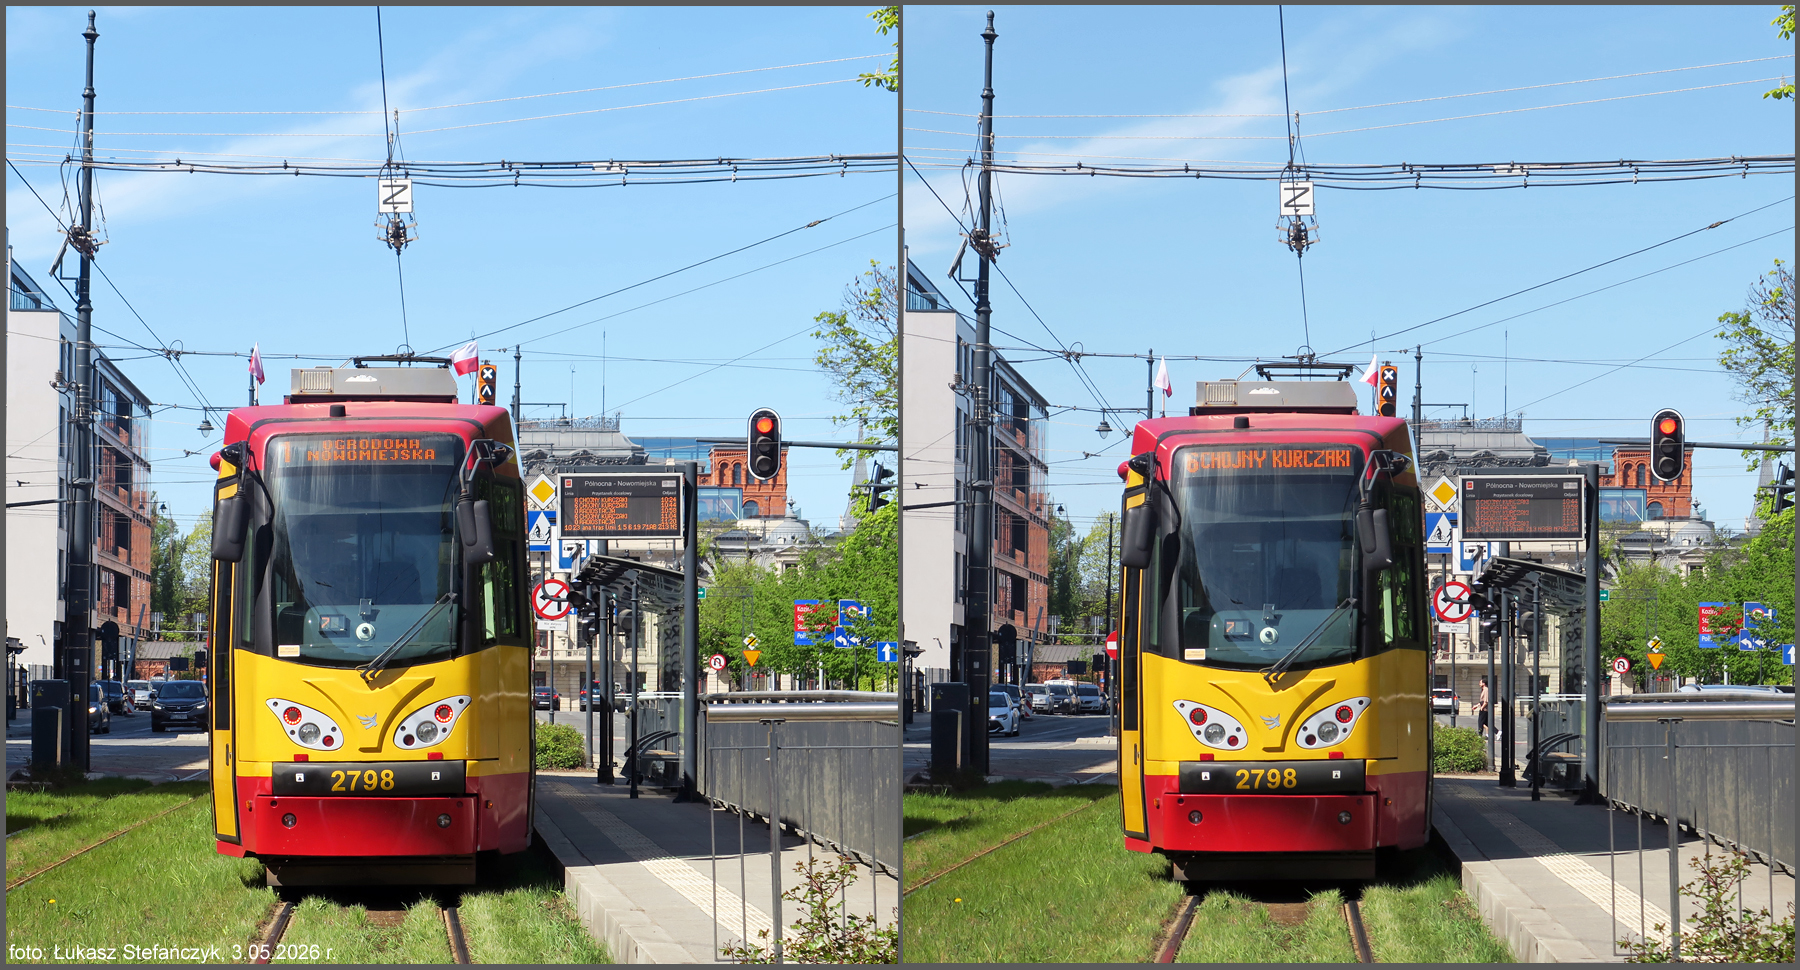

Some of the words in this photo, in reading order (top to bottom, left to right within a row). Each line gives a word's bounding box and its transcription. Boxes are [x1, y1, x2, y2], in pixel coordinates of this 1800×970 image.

[280, 441, 291, 463] 1
[322, 438, 420, 450] OGRODOWA
[307, 449, 436, 461] NOWOMIEJSKA
[1187, 452, 1199, 473] 6
[1200, 450, 1266, 469] CHOJNY
[1272, 450, 1350, 468] KURCZAKI
[617, 480, 657, 488] Nowomiejska
[1518, 482, 1558, 490] Nowomiejska
[331, 769, 395, 792] 2798
[1235, 768, 1298, 789] 2798
